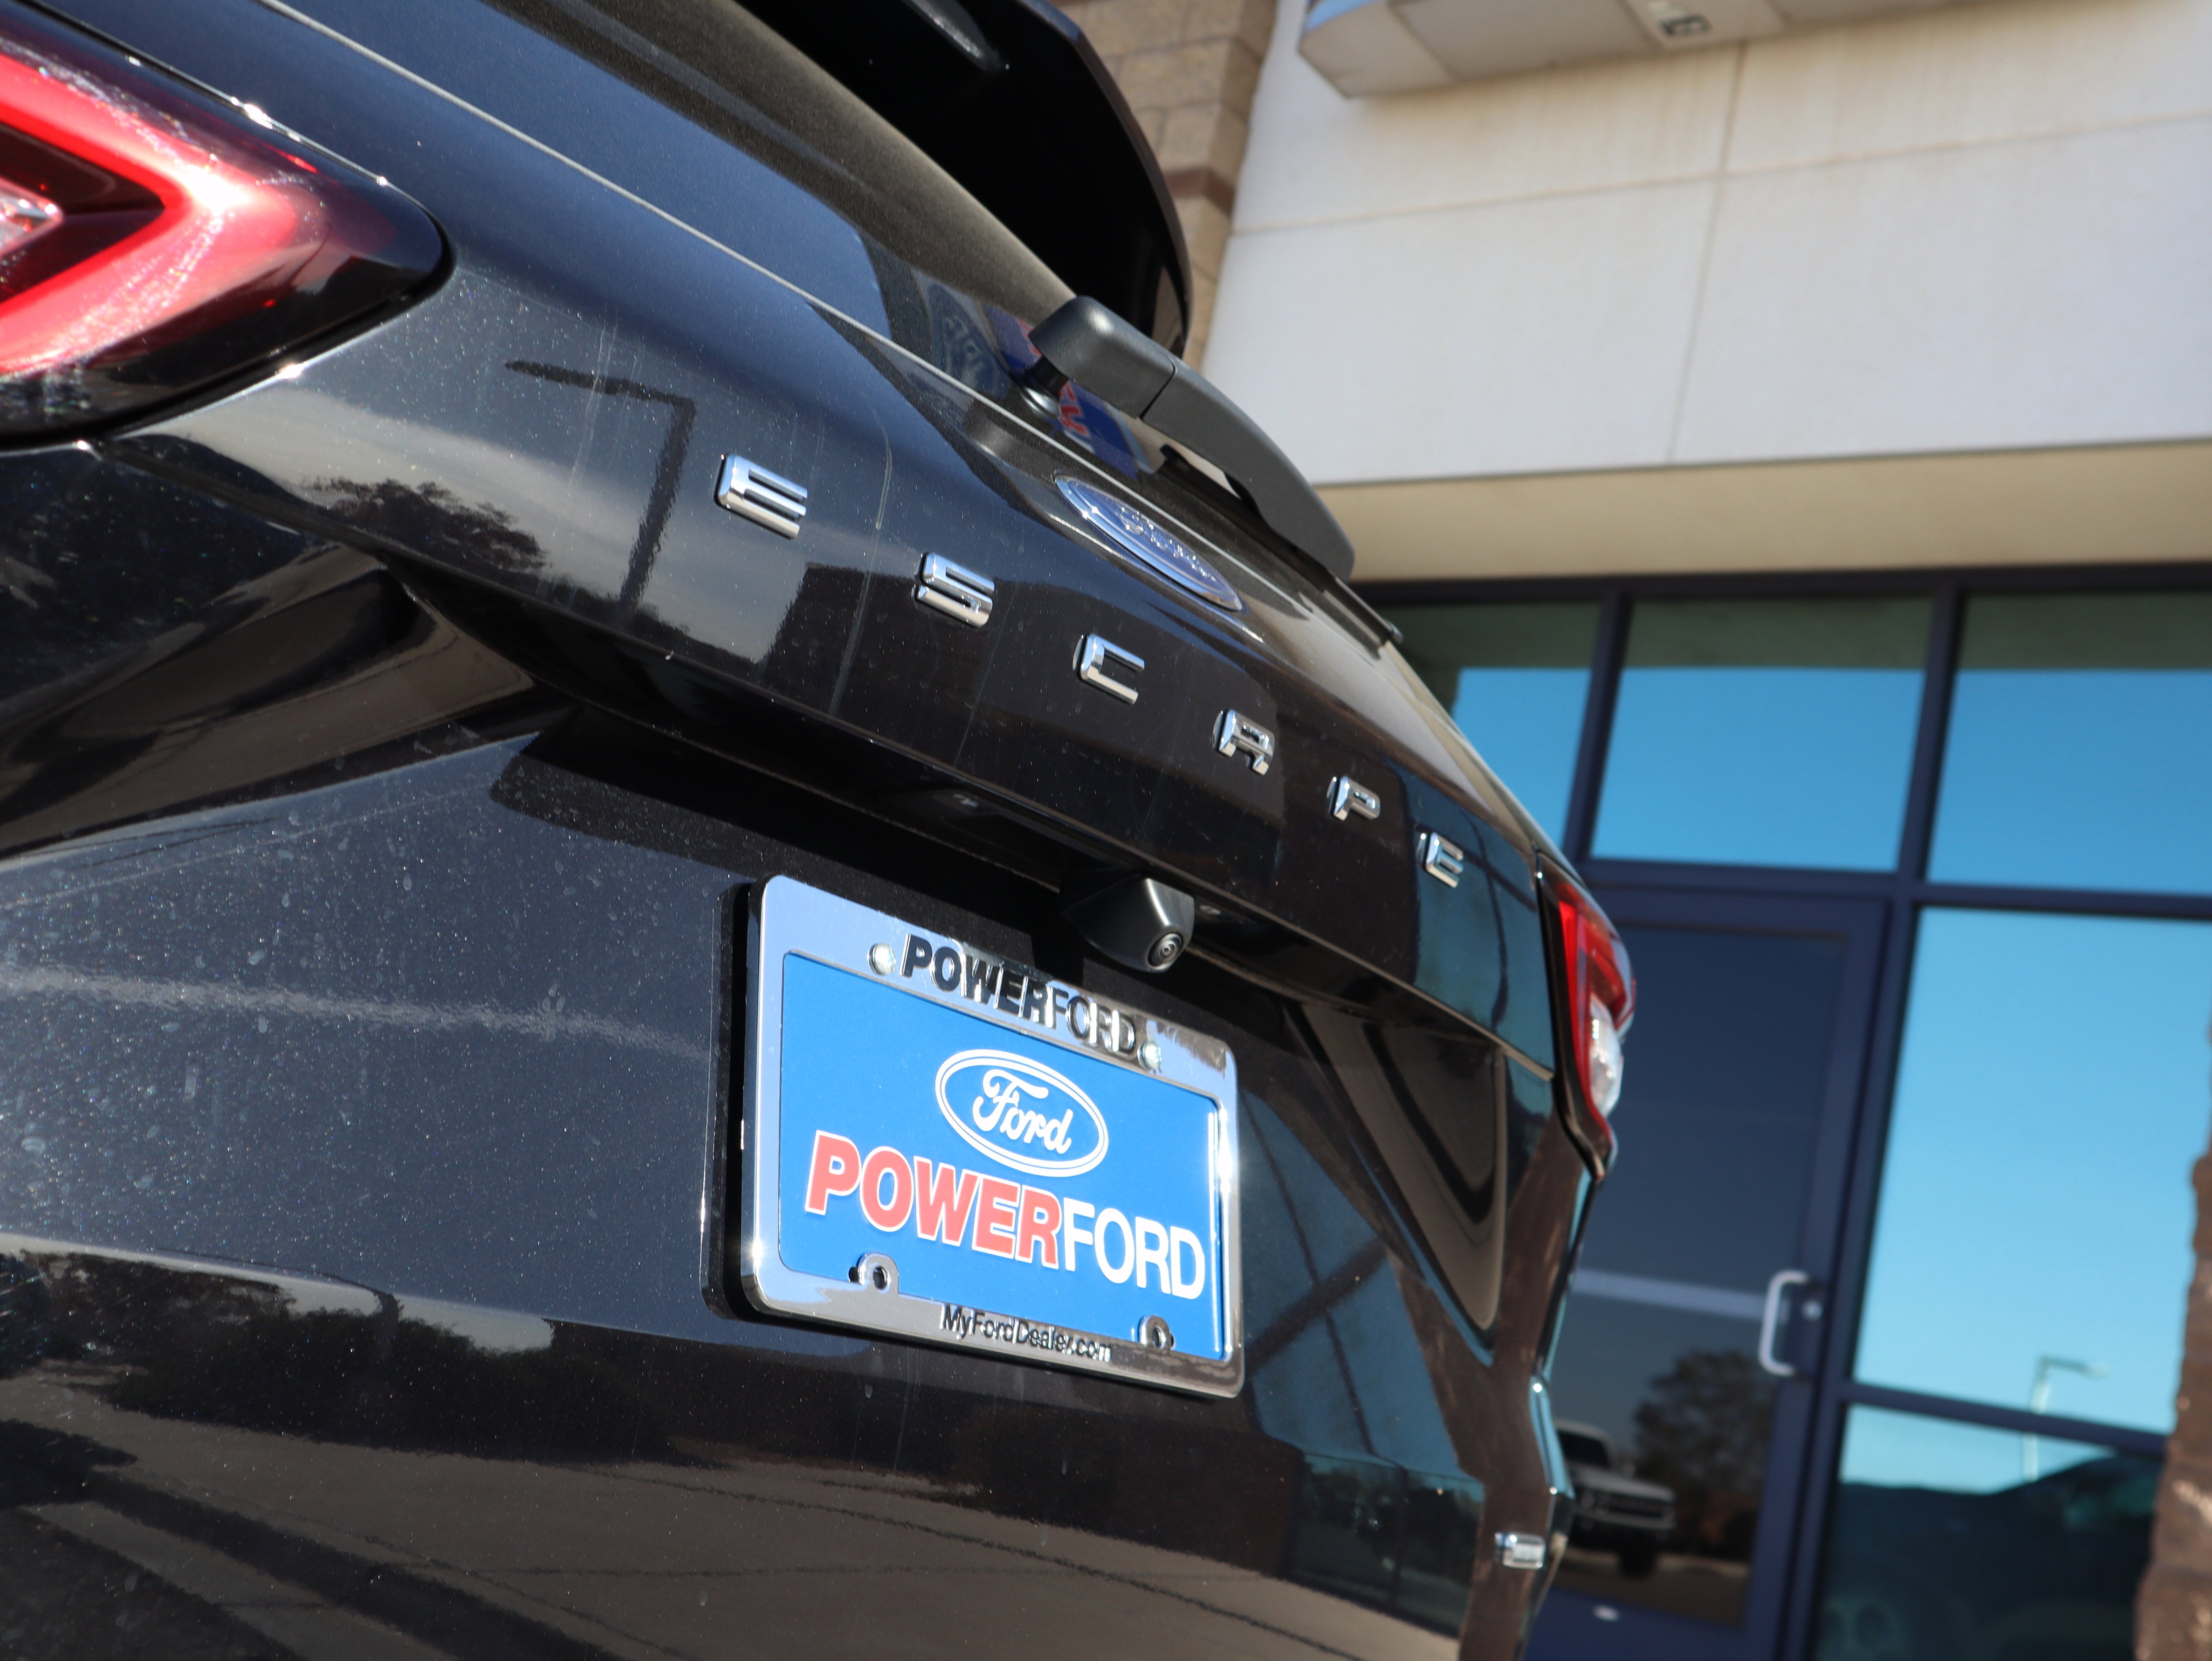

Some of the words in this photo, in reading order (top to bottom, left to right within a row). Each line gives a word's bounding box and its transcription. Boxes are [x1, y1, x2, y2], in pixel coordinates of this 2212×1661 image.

[717, 453, 1463, 888] ESCAPE
[972, 1069, 1073, 1154] Ford
[940, 1303, 1112, 1362] MyFordDealer.com
